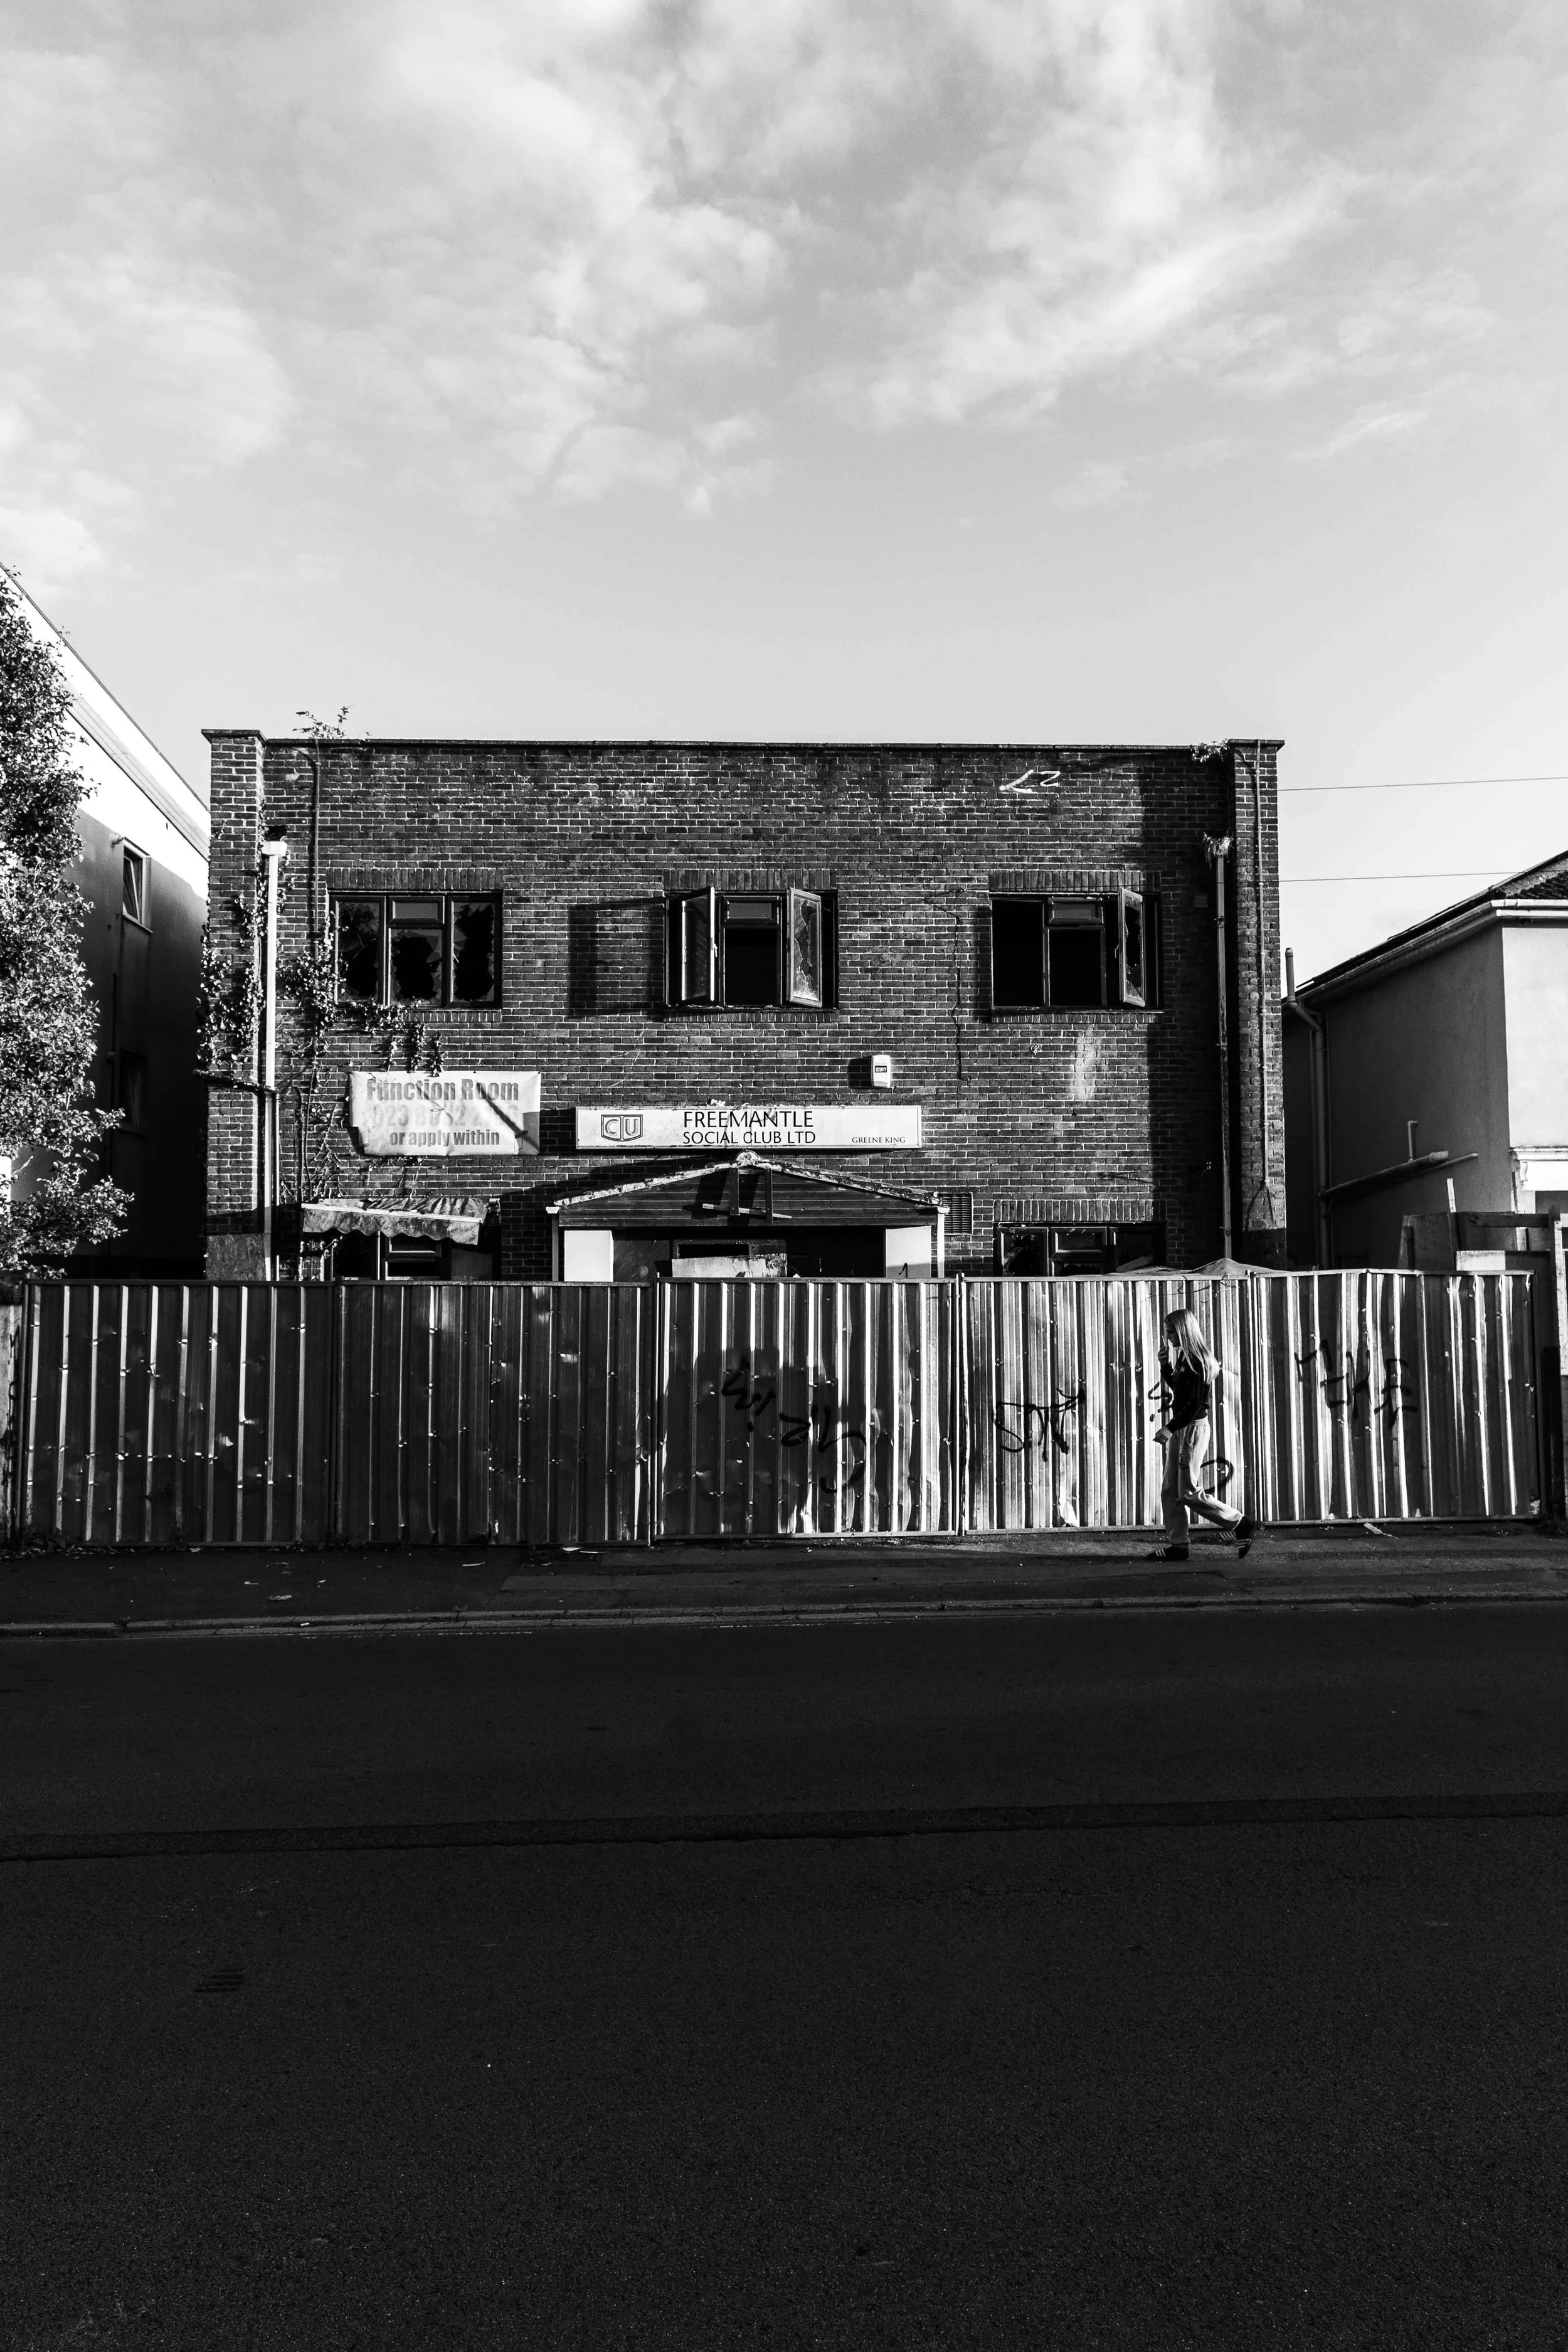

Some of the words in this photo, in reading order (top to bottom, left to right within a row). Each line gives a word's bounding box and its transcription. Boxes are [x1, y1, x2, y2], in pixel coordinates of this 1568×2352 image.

[366, 1079, 455, 1101] Function
[461, 1079, 519, 1101] Room
[684, 1111, 813, 1128] FREEMANTLE
[389, 1131, 406, 1146] or
[408, 1130, 450, 1147] apply
[453, 1129, 500, 1146] within
[682, 1131, 738, 1144] SOCIAL
[743, 1131, 782, 1144] CLUB
[787, 1131, 815, 1144] LTD
